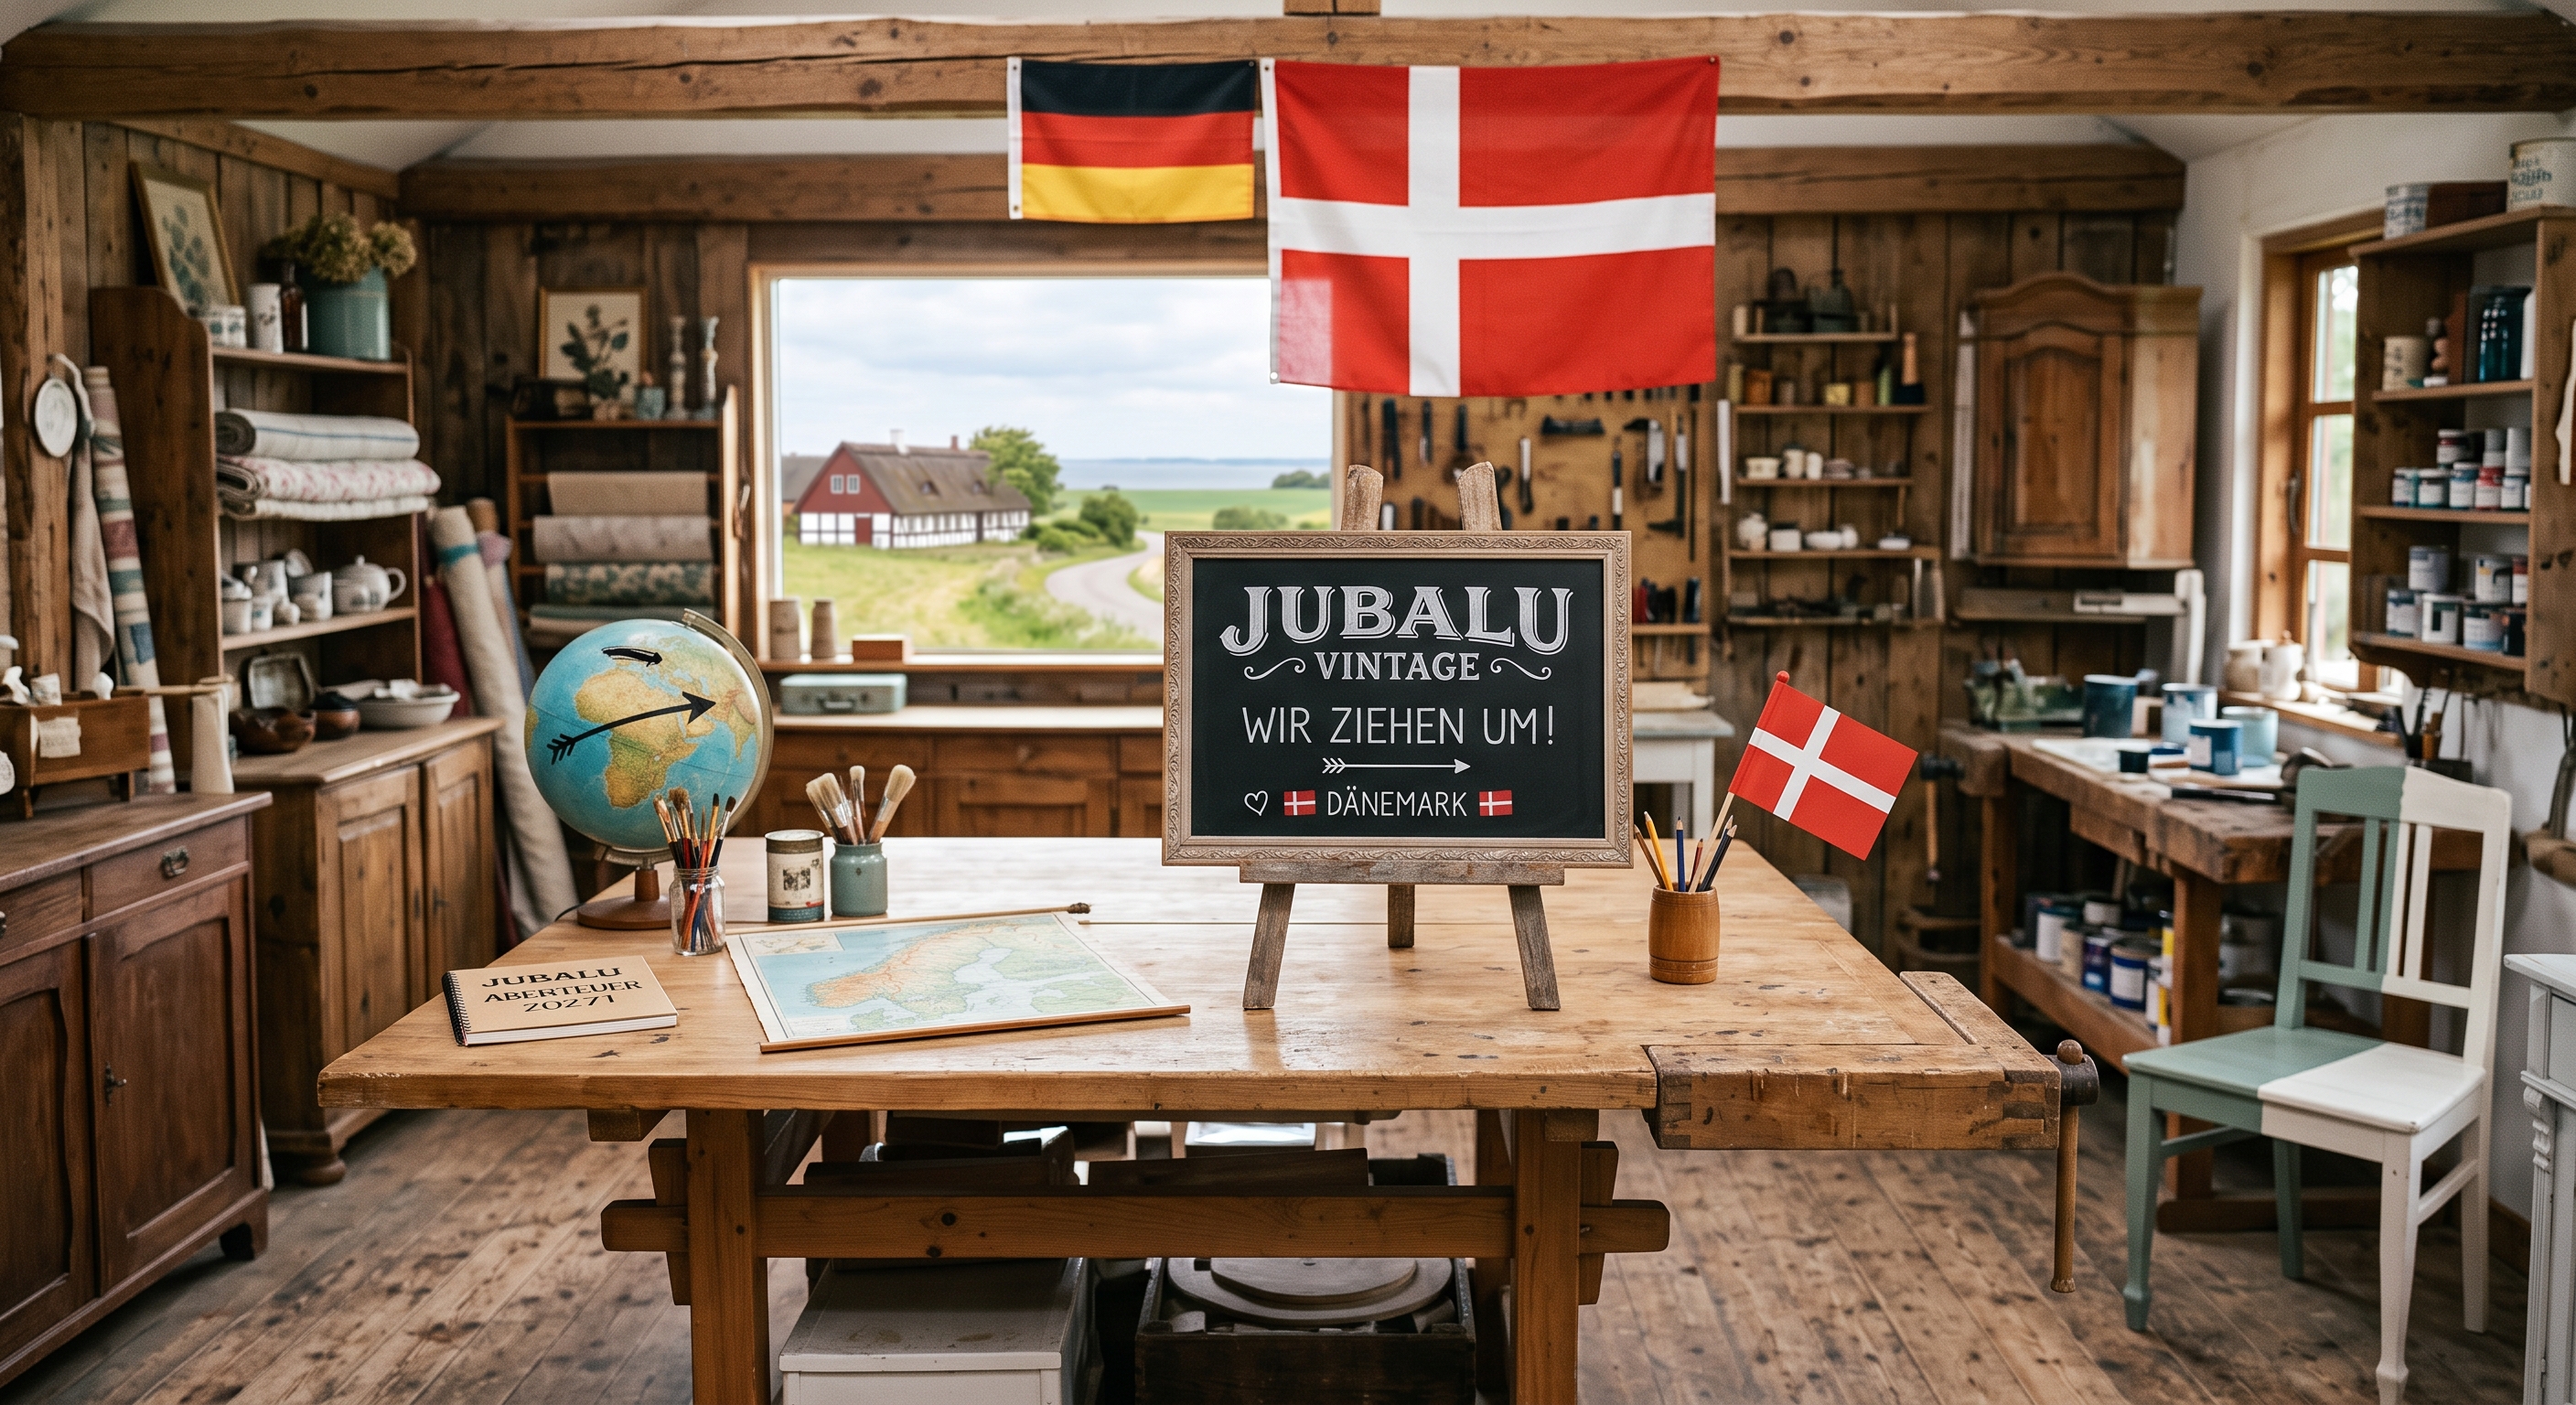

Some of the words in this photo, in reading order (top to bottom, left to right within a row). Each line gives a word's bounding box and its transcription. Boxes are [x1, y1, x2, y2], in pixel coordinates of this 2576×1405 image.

[1219, 586, 1573, 656] JUBALU
[1315, 651, 1480, 681] VINTAGE
[1241, 707, 1313, 744] WIR
[1329, 707, 1464, 745] ZIEHEN
[1483, 706, 1554, 745] UM!
[1327, 786, 1467, 817] DÄNEMARK
[482, 968, 622, 988] JUBALU
[484, 980, 642, 1003] ABERTEUER
